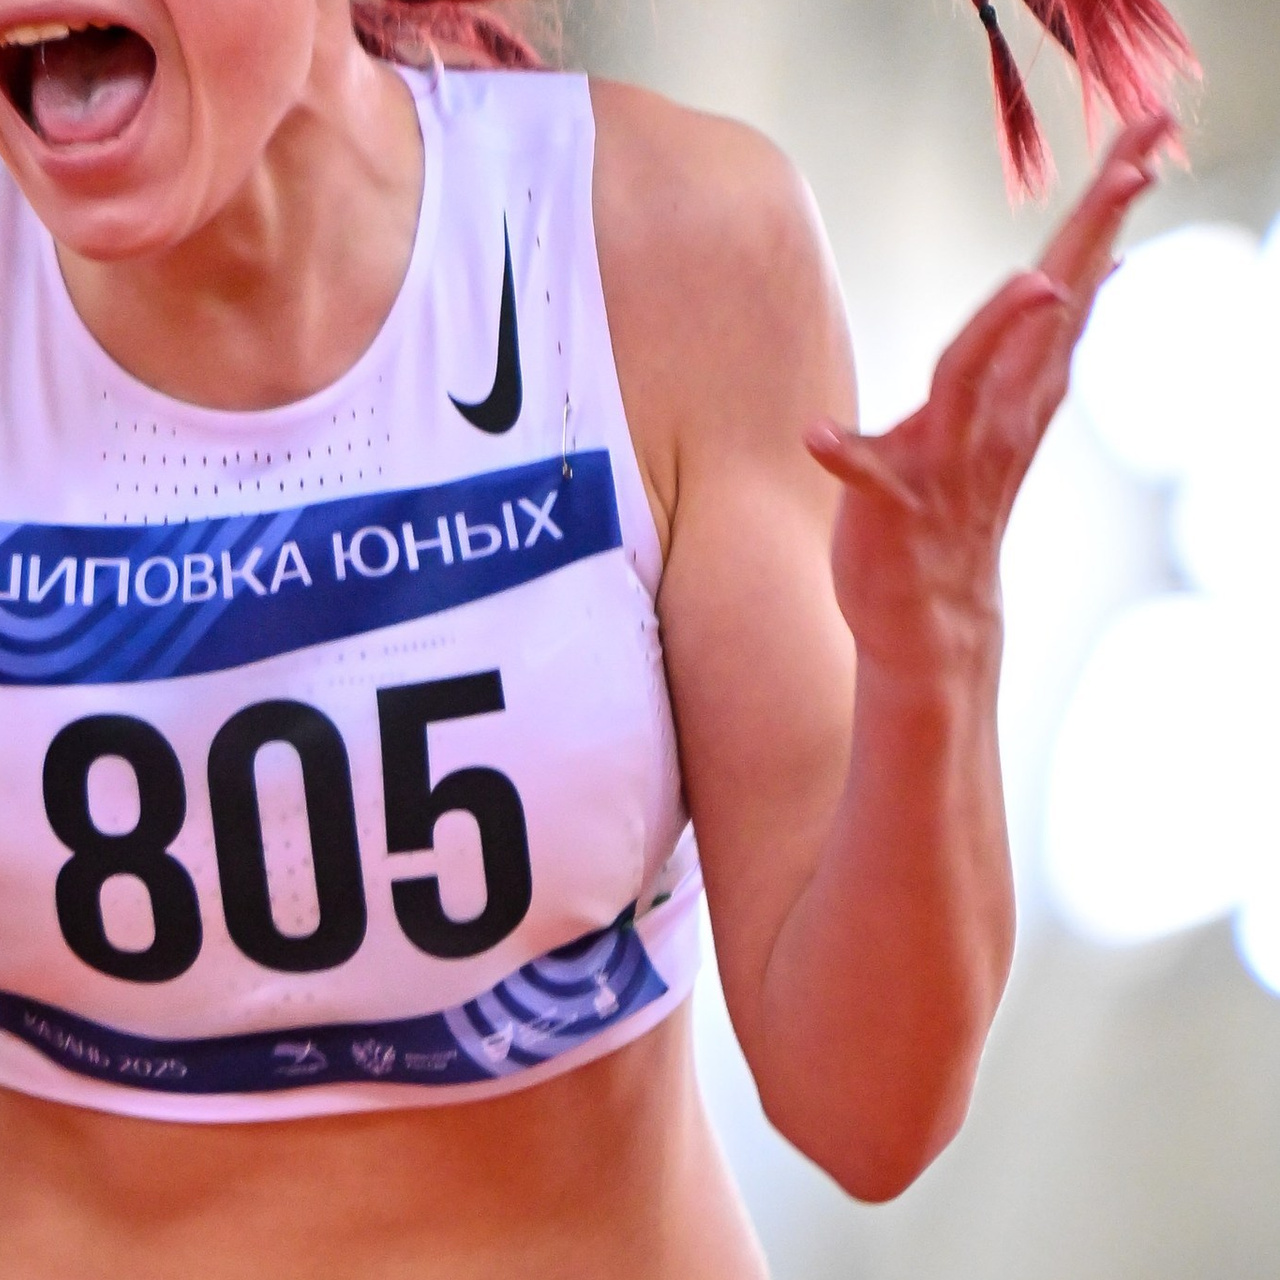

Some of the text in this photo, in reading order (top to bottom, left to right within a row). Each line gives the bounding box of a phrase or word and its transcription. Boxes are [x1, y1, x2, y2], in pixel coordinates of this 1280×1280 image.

[332, 488, 566, 582] ЮНЫХ
[41, 667, 533, 984] 805
[119, 1055, 189, 1079] 2025
